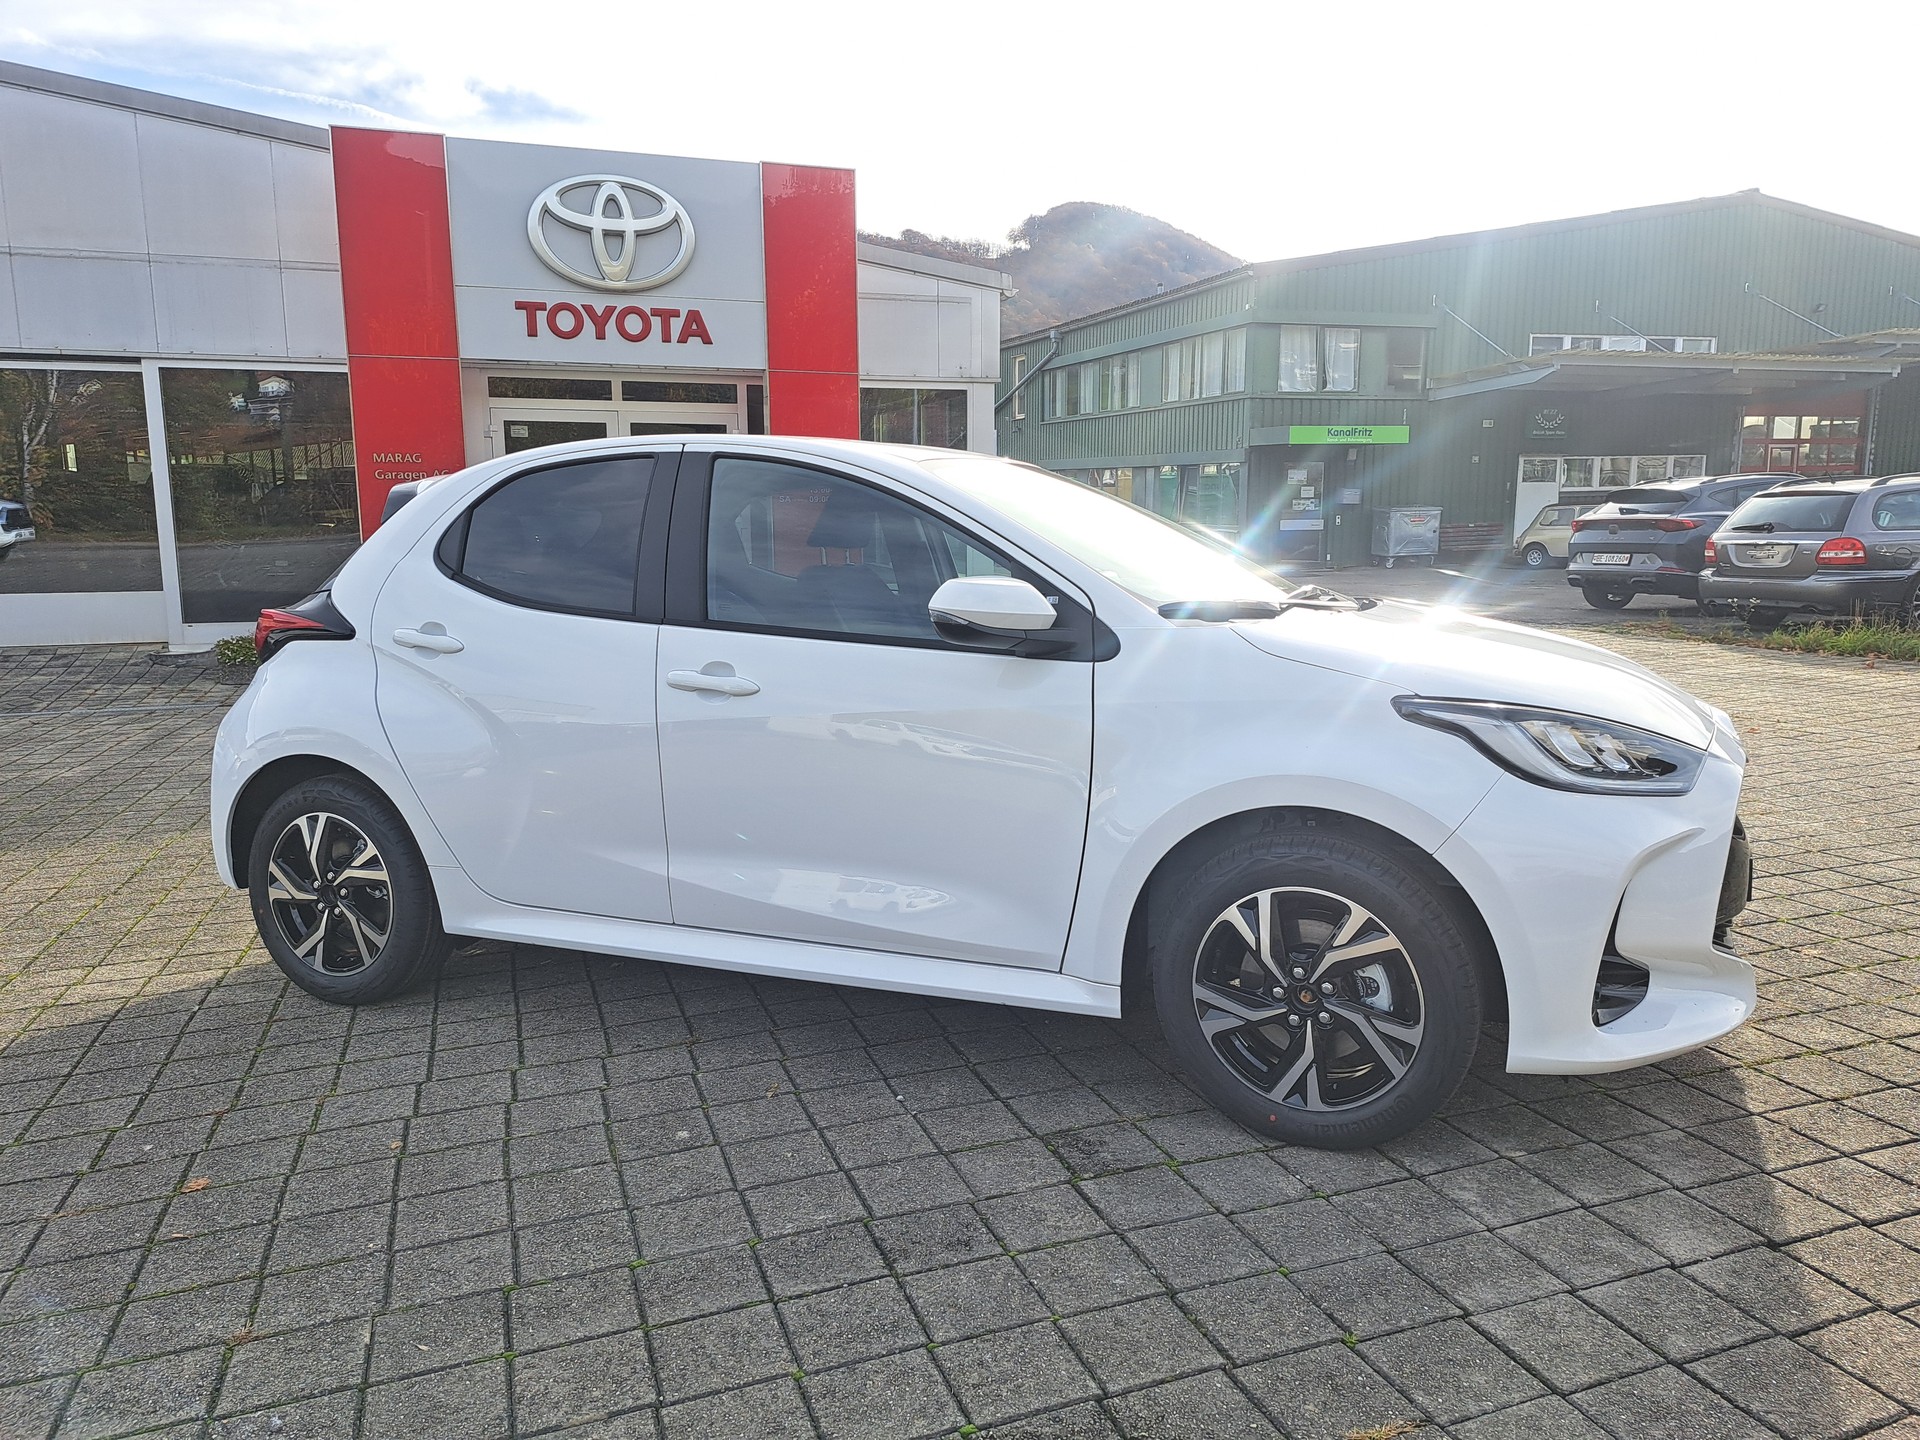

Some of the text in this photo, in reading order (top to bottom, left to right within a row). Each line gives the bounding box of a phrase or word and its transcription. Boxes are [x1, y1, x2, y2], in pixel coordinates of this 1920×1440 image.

[514, 300, 714, 345] TOYOTA
[1327, 427, 1373, 437] KanalFritz
[373, 453, 422, 463] MARAG
[375, 469, 427, 481] Garagen
[779, 495, 791, 503] SA
